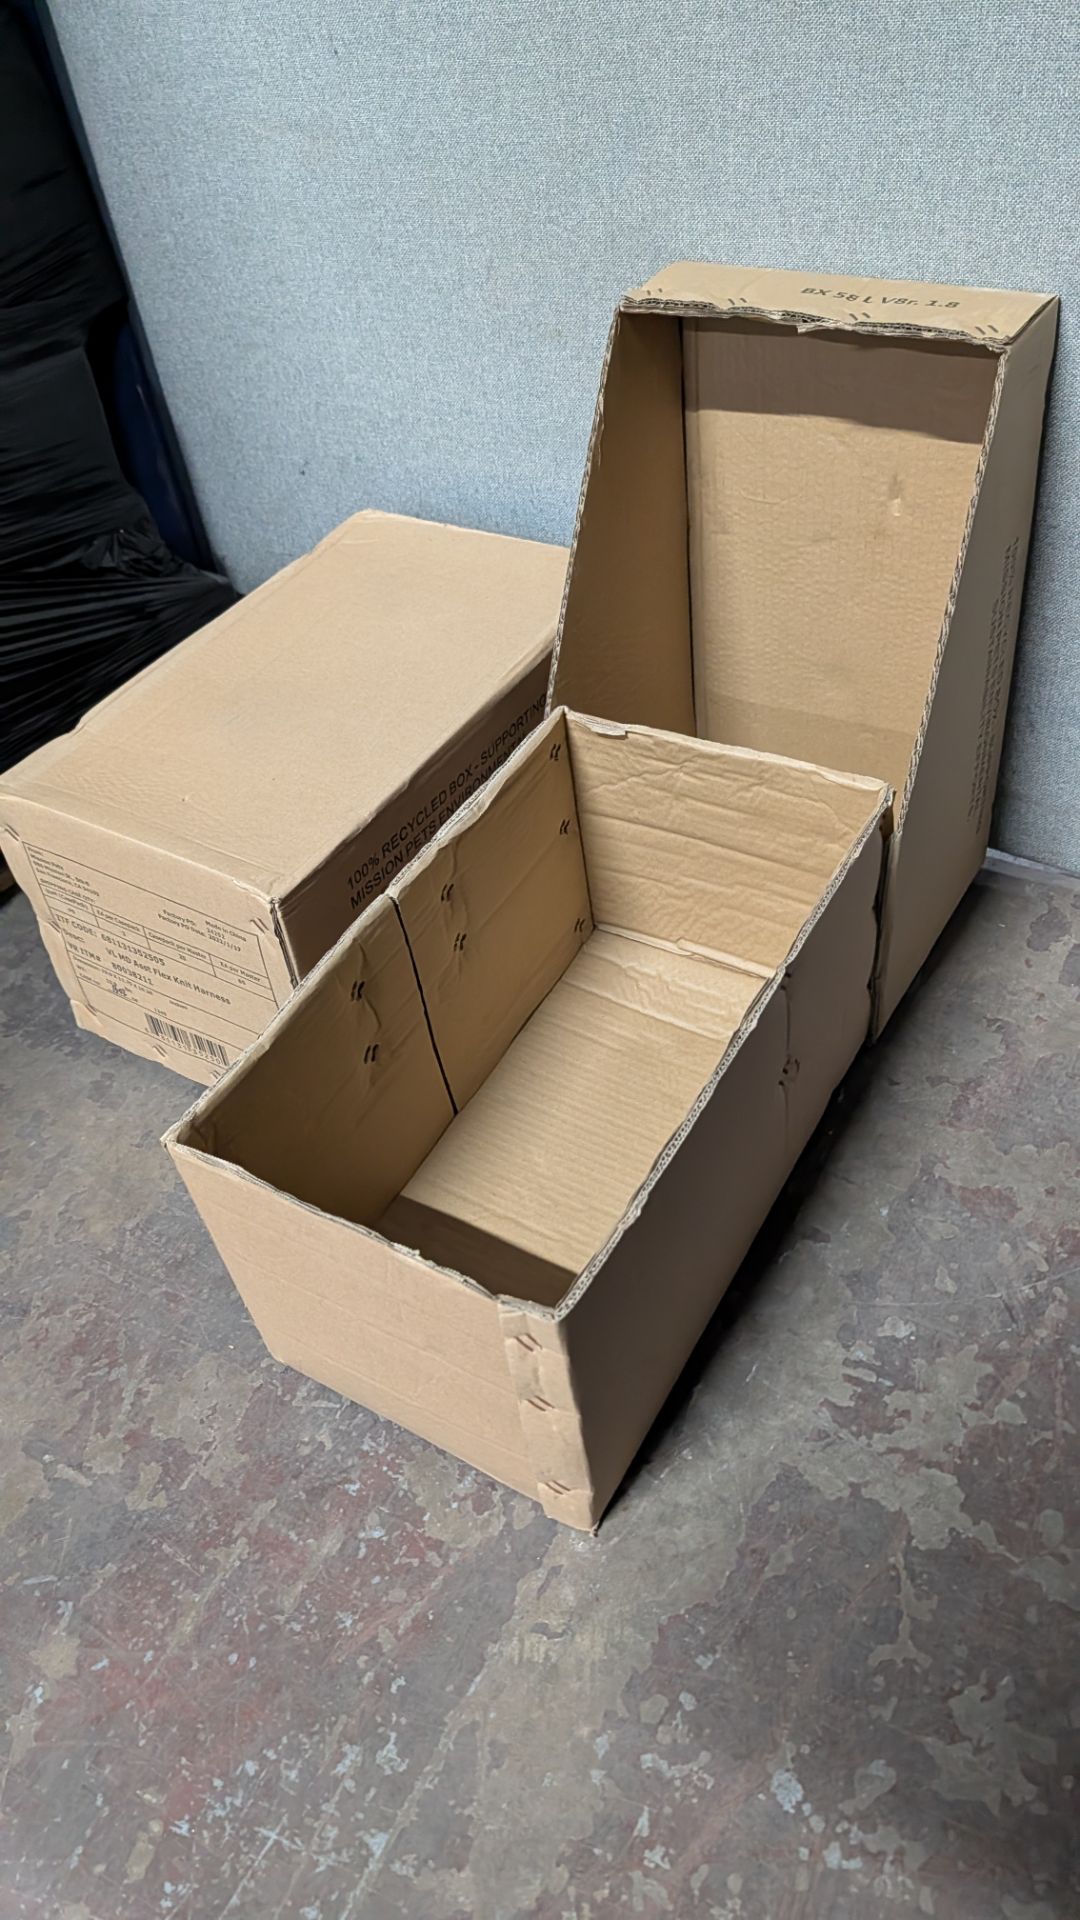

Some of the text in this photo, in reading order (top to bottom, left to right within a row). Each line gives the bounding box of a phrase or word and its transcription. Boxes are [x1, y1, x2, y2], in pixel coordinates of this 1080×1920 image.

[801, 287, 831, 296] BX
[833, 291, 860, 302] 58
[348, 853, 380, 890] 100%
[382, 789, 447, 858] RECYCLED
[448, 763, 473, 796] BOX
[350, 734, 527, 910] MISSION PETS ENVIRONMENT
[153, 967, 172, 980] Flex
[173, 976, 192, 988] Knit
[193, 984, 231, 1004] Harness
